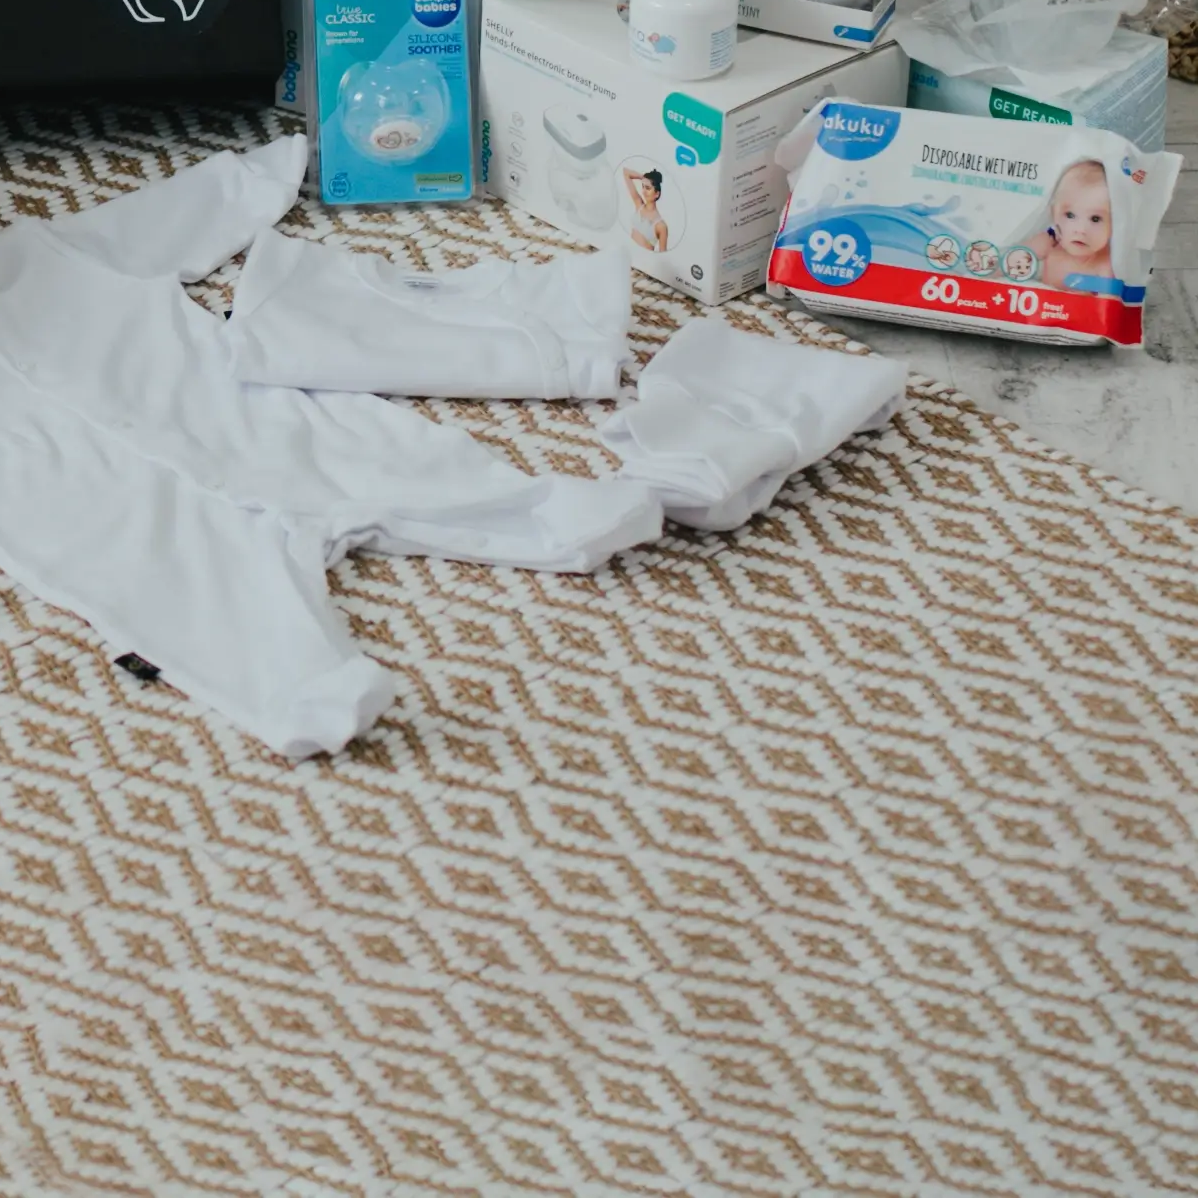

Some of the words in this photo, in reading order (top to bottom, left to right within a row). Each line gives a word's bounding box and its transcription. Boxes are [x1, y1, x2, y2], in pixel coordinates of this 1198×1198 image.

[336, 4, 363, 15] true
[414, 2, 457, 13] babies
[325, 13, 376, 25] CLASSIC
[486, 18, 515, 38] SHELLY
[407, 33, 462, 44] SILICONE
[407, 44, 462, 56] SOOTHER
[282, 30, 300, 103] babyono
[485, 29, 526, 56] hands-free
[527, 52, 566, 76] electronic
[566, 69, 592, 89] breast
[593, 84, 617, 101] pump
[993, 98, 1020, 116] GET
[666, 109, 685, 124] GET
[685, 118, 717, 140] READY!
[824, 113, 886, 137] akuku
[921, 143, 983, 172] DISPOSABLE
[985, 156, 1006, 175] WET
[1007, 160, 1039, 181] WIPES
[808, 229, 867, 269] 99%
[811, 262, 855, 280] WATER
[921, 276, 960, 304] 60
